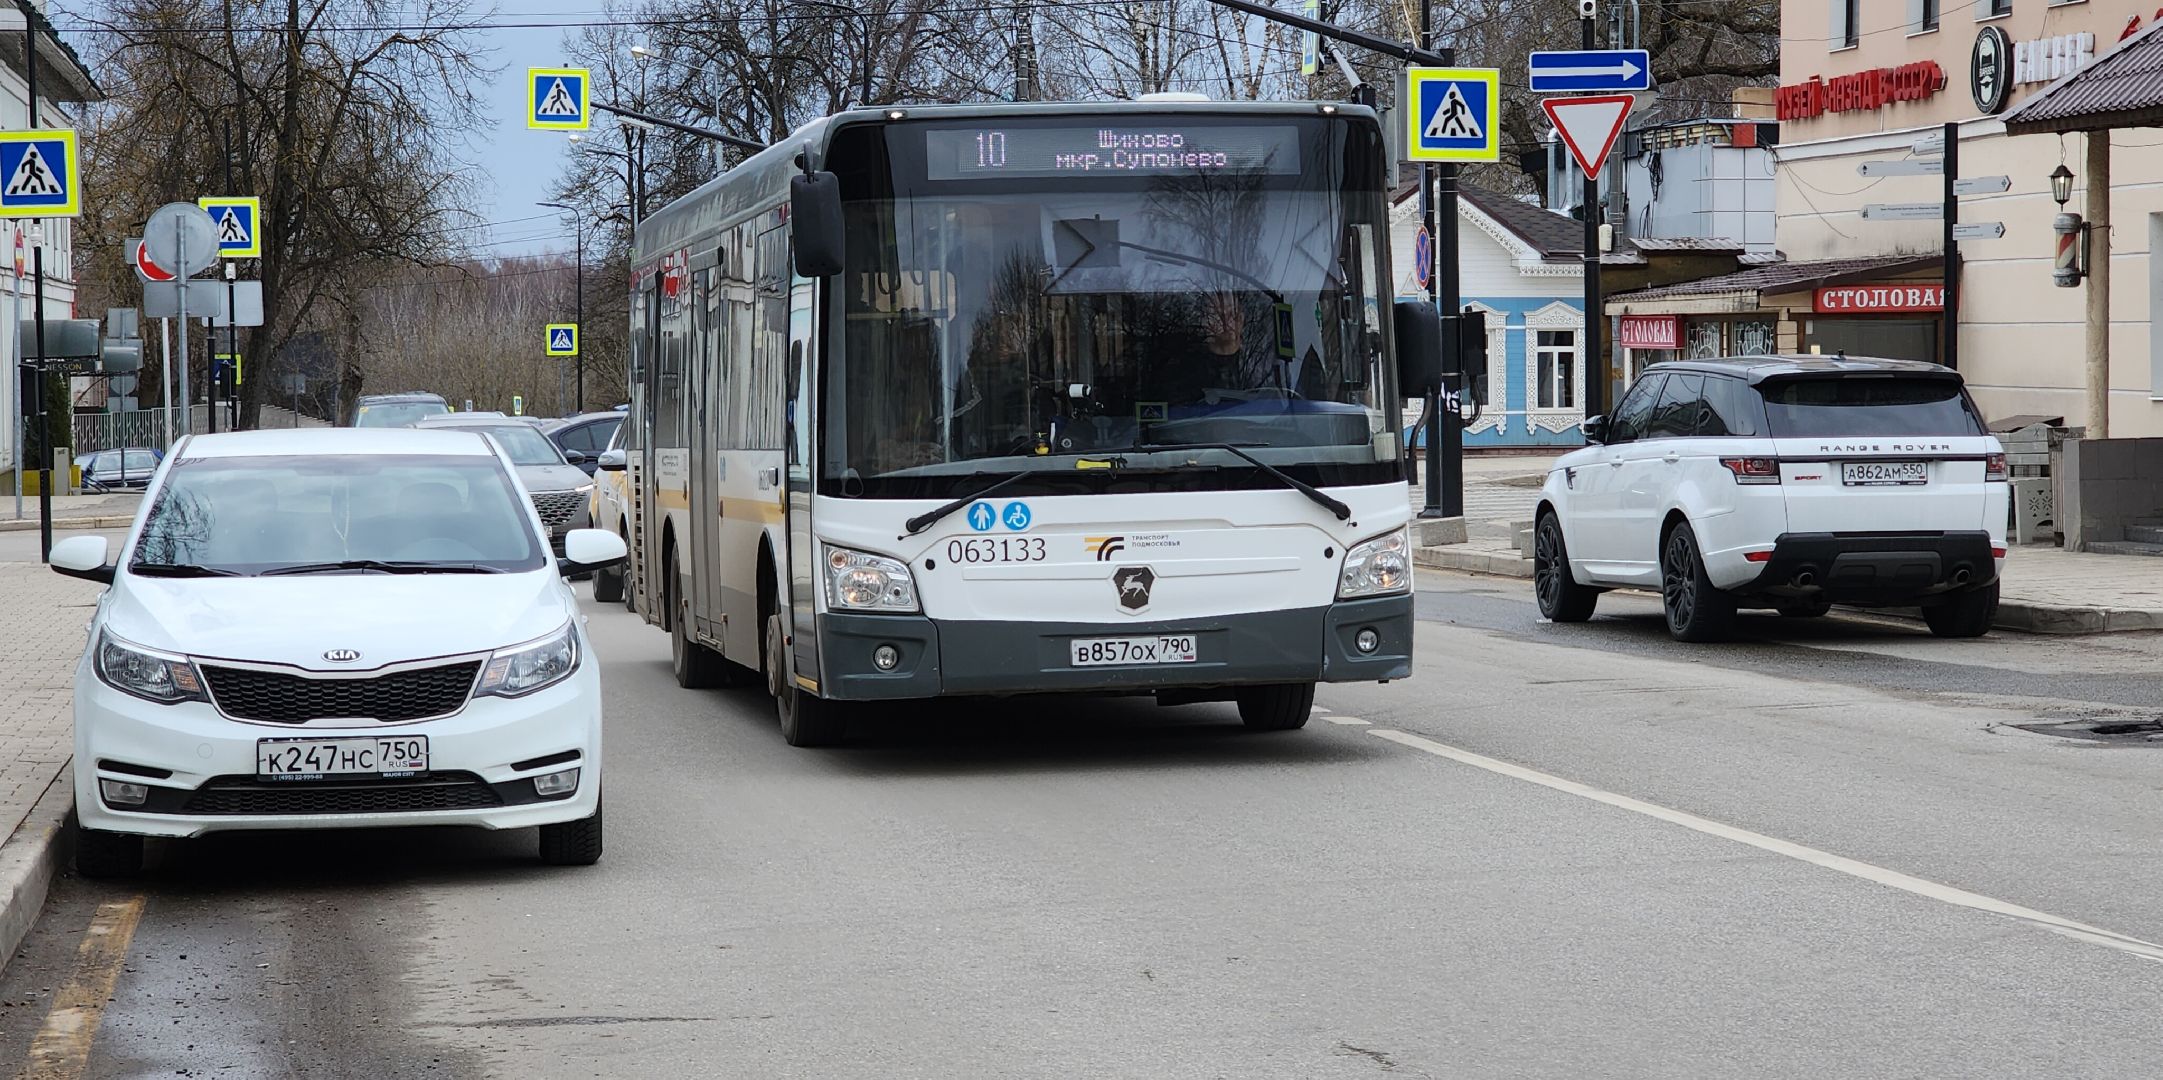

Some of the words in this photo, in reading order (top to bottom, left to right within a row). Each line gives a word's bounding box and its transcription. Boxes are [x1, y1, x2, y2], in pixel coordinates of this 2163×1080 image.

[1776, 75, 1822, 121] МУЗЕЙ
[1877, 68, 1893, 104] В
[976, 131, 1006, 167] 10
[1056, 149, 1227, 170] мкр.Супонево
[1622, 320, 1674, 343] СТОЛОВАЯ
[1902, 464, 1923, 475] 550
[947, 537, 1046, 563] 063133
[328, 650, 357, 660] KIA
[1160, 638, 1190, 654] 790
[379, 741, 420, 761] 750
[388, 760, 408, 769] RUS
